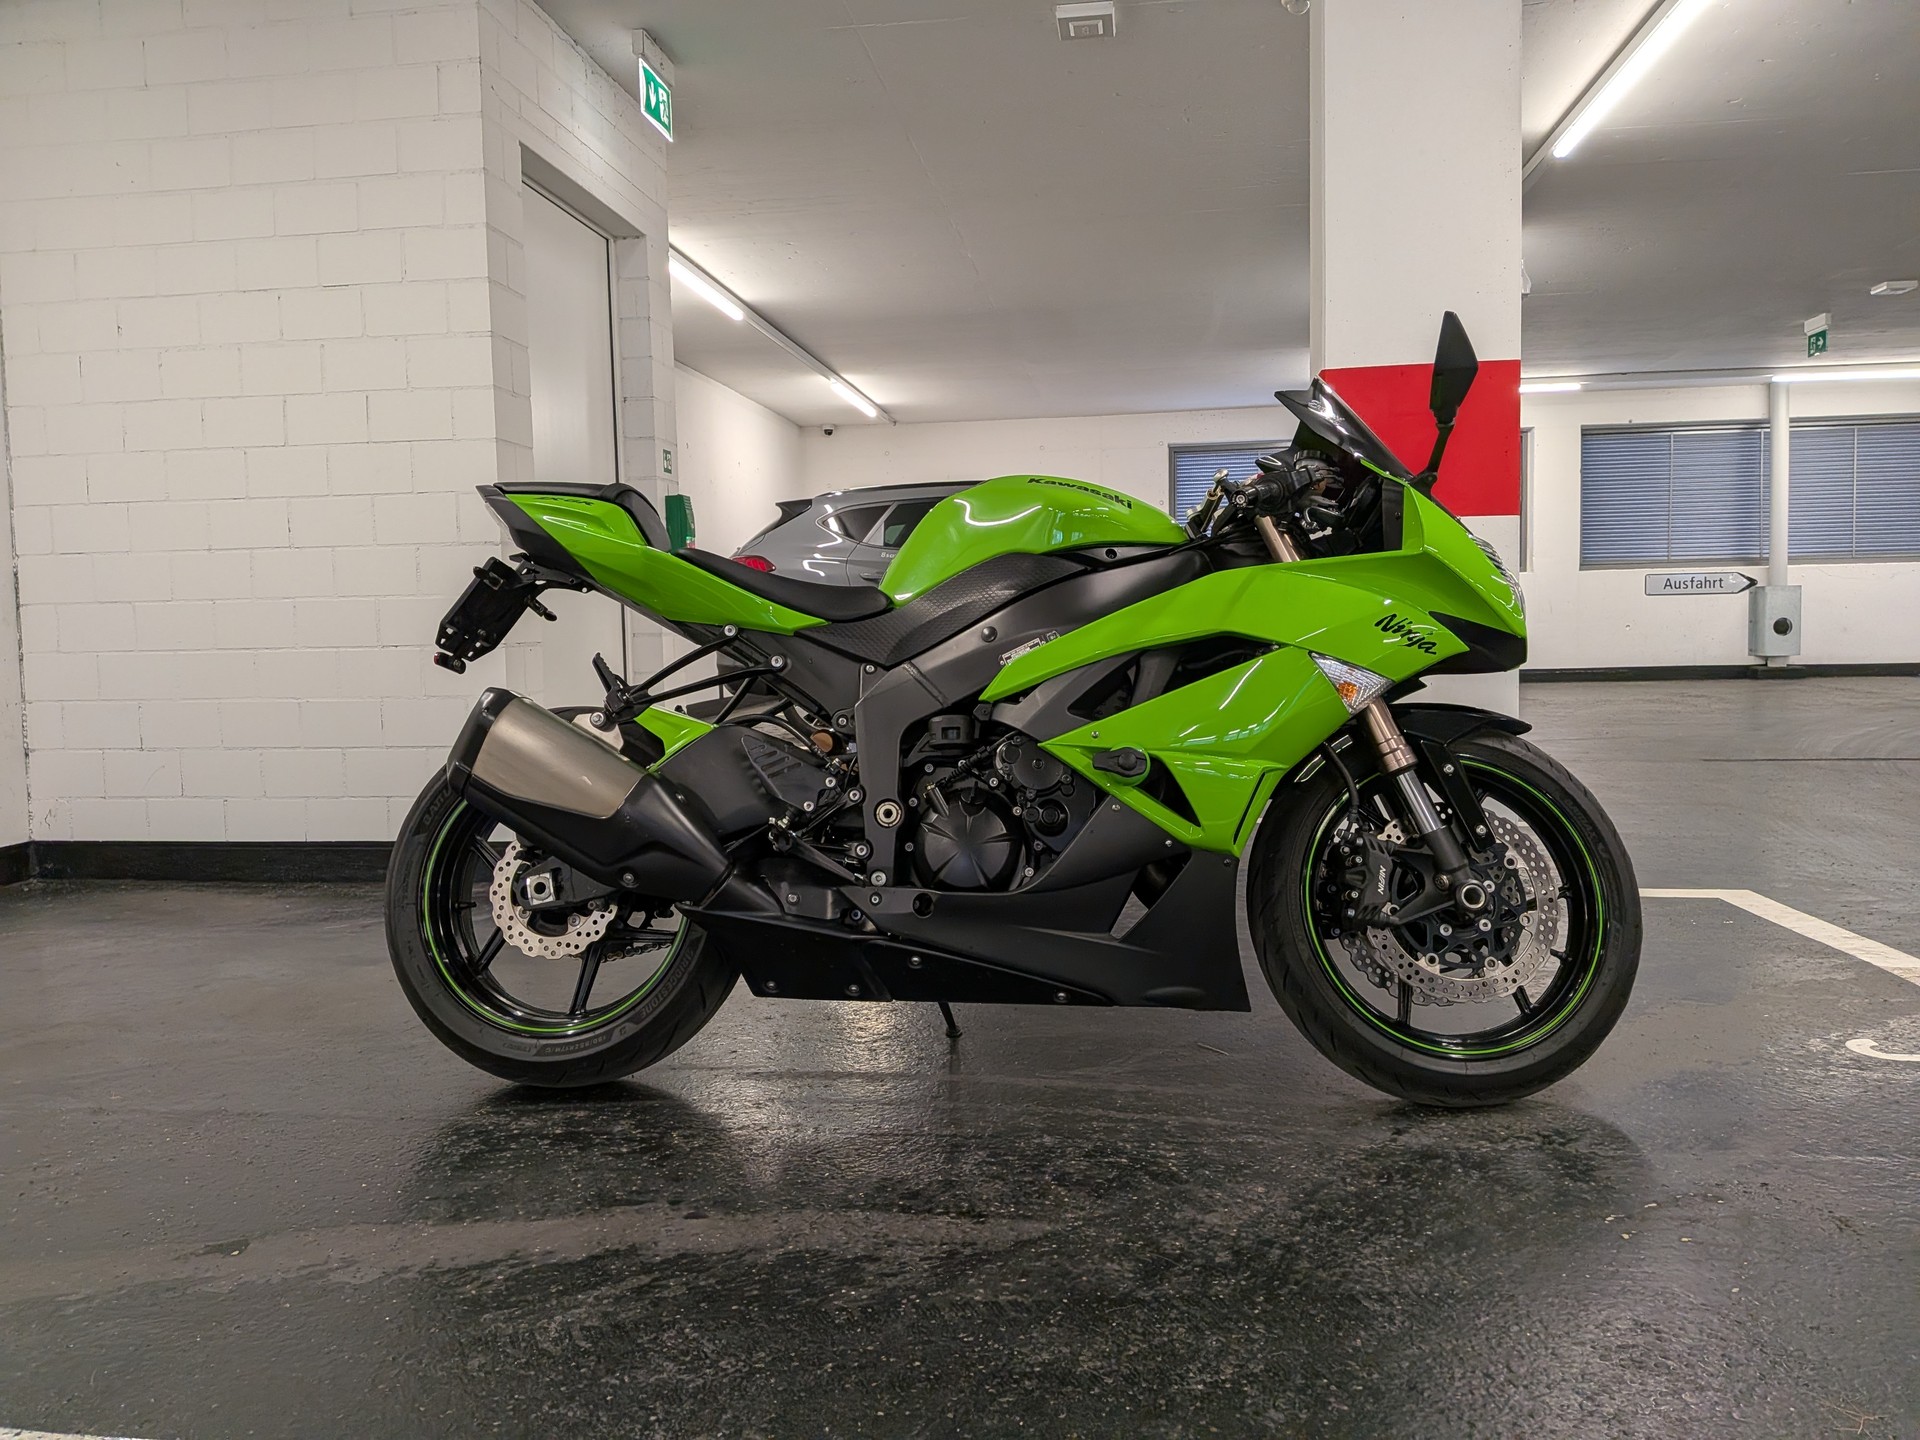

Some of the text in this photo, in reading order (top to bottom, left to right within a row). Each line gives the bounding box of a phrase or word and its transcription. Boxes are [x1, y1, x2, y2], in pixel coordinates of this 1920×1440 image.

[1027, 477, 1132, 510] Kawasaki
[1663, 576, 1724, 590] Ausfahrt
[1374, 613, 1437, 655] Ninja
